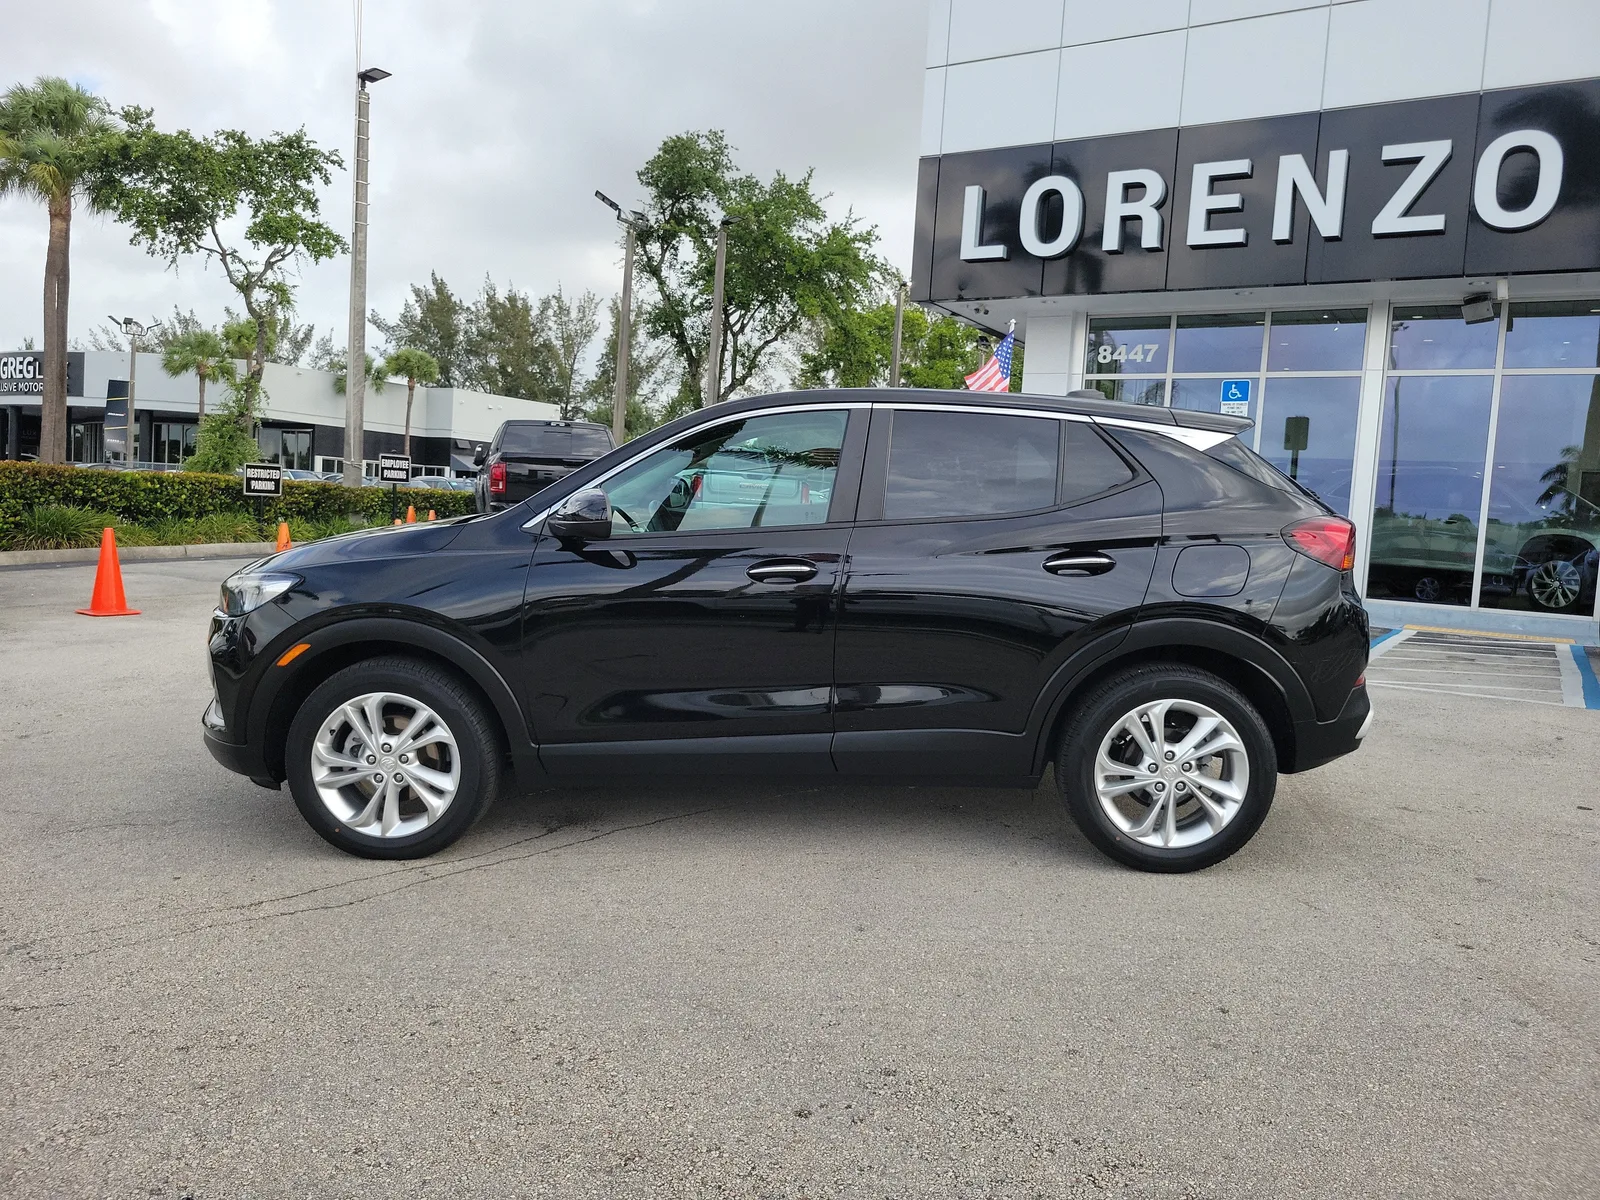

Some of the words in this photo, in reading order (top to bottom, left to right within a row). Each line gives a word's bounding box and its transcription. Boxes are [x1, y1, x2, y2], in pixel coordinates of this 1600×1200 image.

[960, 128, 1565, 263] LORENZO
[1097, 343, 1159, 364] 8447
[0, 356, 34, 379] GREG
[0, 382, 17, 392] USIVE
[18, 382, 44, 392] MOTOR
[381, 458, 410, 469] EMPLOYEE
[246, 468, 281, 480] RESTRICTED
[383, 469, 407, 480] PARKING
[250, 480, 275, 491] PARKING
